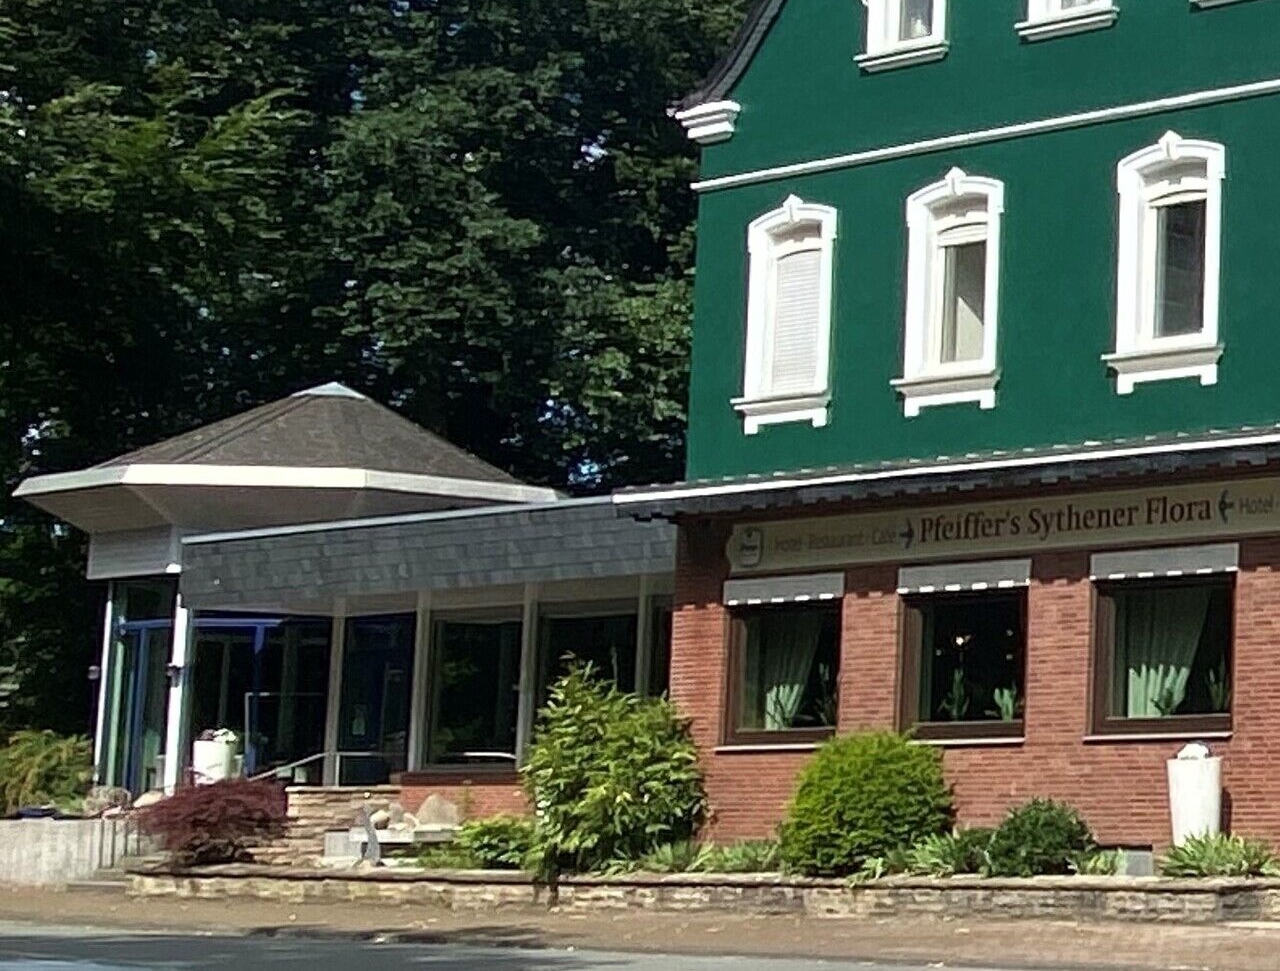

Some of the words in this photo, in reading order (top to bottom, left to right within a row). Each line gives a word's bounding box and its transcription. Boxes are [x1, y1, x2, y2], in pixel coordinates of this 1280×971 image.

[919, 512, 1021, 543] Pfeiffer's
[1027, 504, 1139, 541] Sythener
[1145, 496, 1212, 525] Flora
